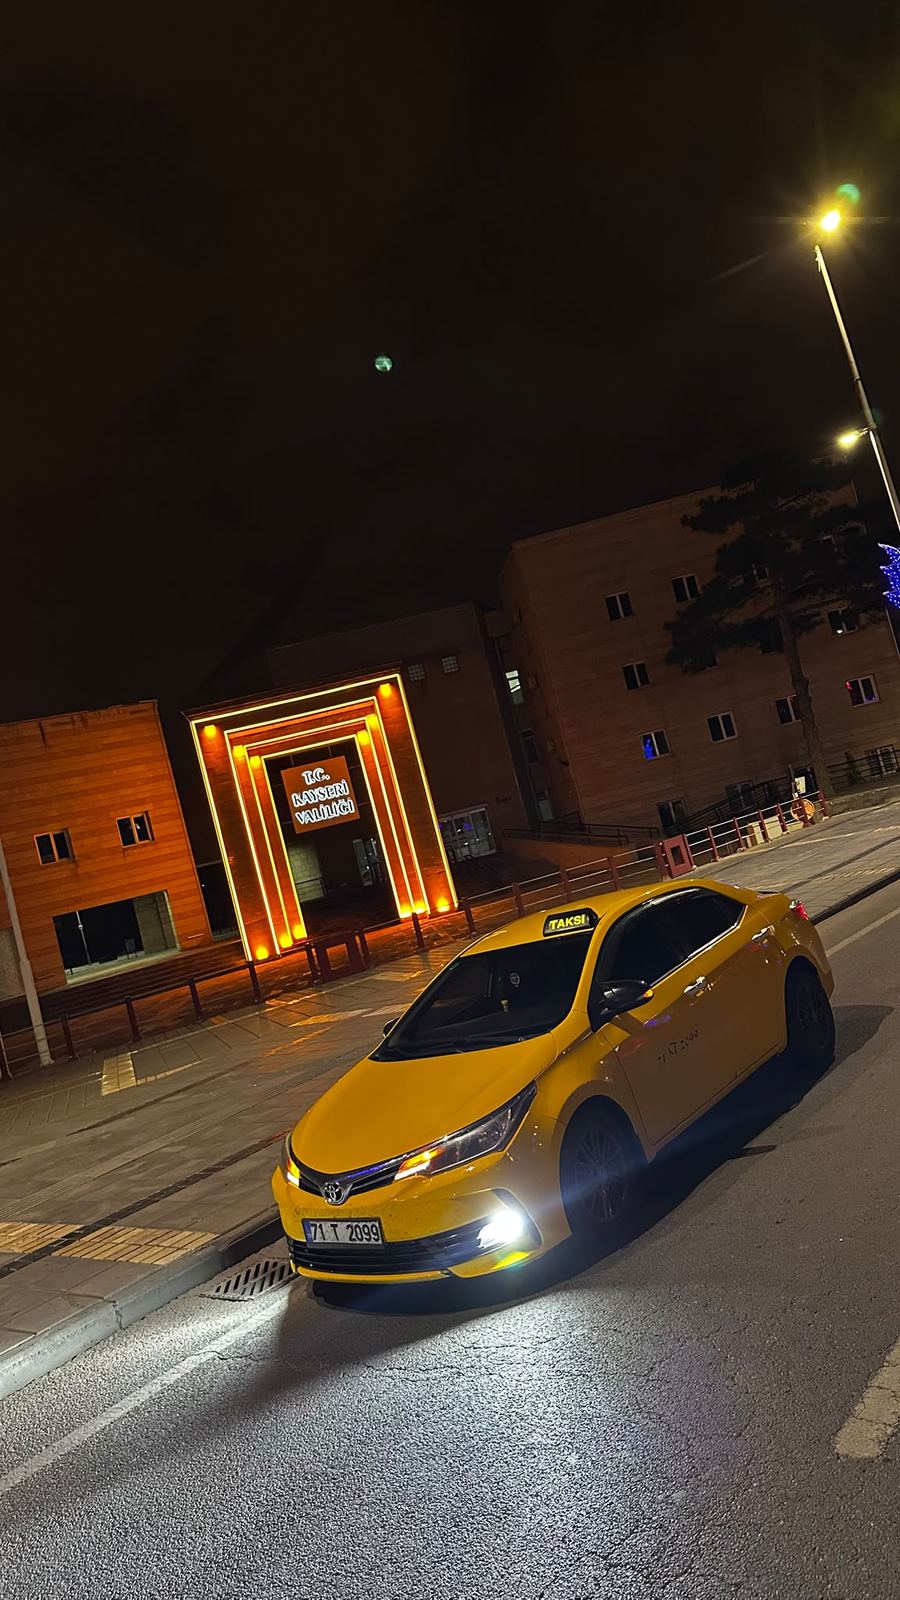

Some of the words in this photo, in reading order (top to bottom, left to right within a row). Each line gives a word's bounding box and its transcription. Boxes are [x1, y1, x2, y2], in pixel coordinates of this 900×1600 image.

[301, 767, 331, 785] T.C.
[291, 778, 349, 807] KAYSERİ
[295, 797, 355, 825] VALİLİĞİ
[549, 914, 586, 930] TAKSI
[310, 1223, 326, 1241] 71
[330, 1223, 340, 1241] T
[346, 1223, 380, 1242] 2099
